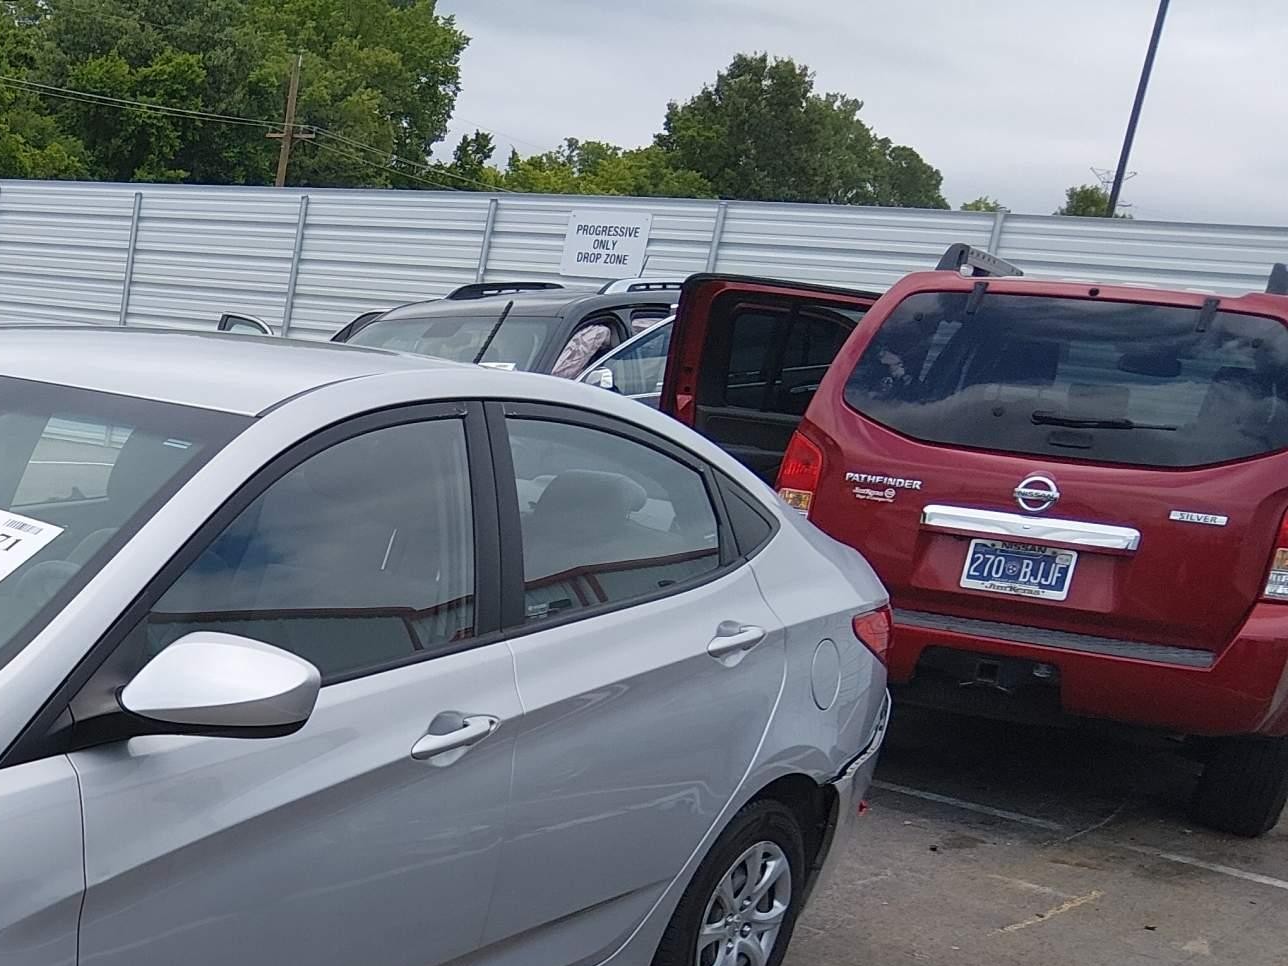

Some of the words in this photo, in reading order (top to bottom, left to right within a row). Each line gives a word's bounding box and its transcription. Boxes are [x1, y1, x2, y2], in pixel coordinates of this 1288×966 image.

[576, 224, 640, 238] PROGRESSIVE
[592, 239, 618, 251] ONLY
[576, 252, 602, 263] DROP
[603, 253, 629, 265] ZONE
[845, 472, 922, 490] PATHFINDER
[1178, 512, 1218, 523] SILVER
[1001, 542, 1047, 554] NISSAN
[969, 553, 1005, 578] 270
[1018, 559, 1067, 586] BJJF
